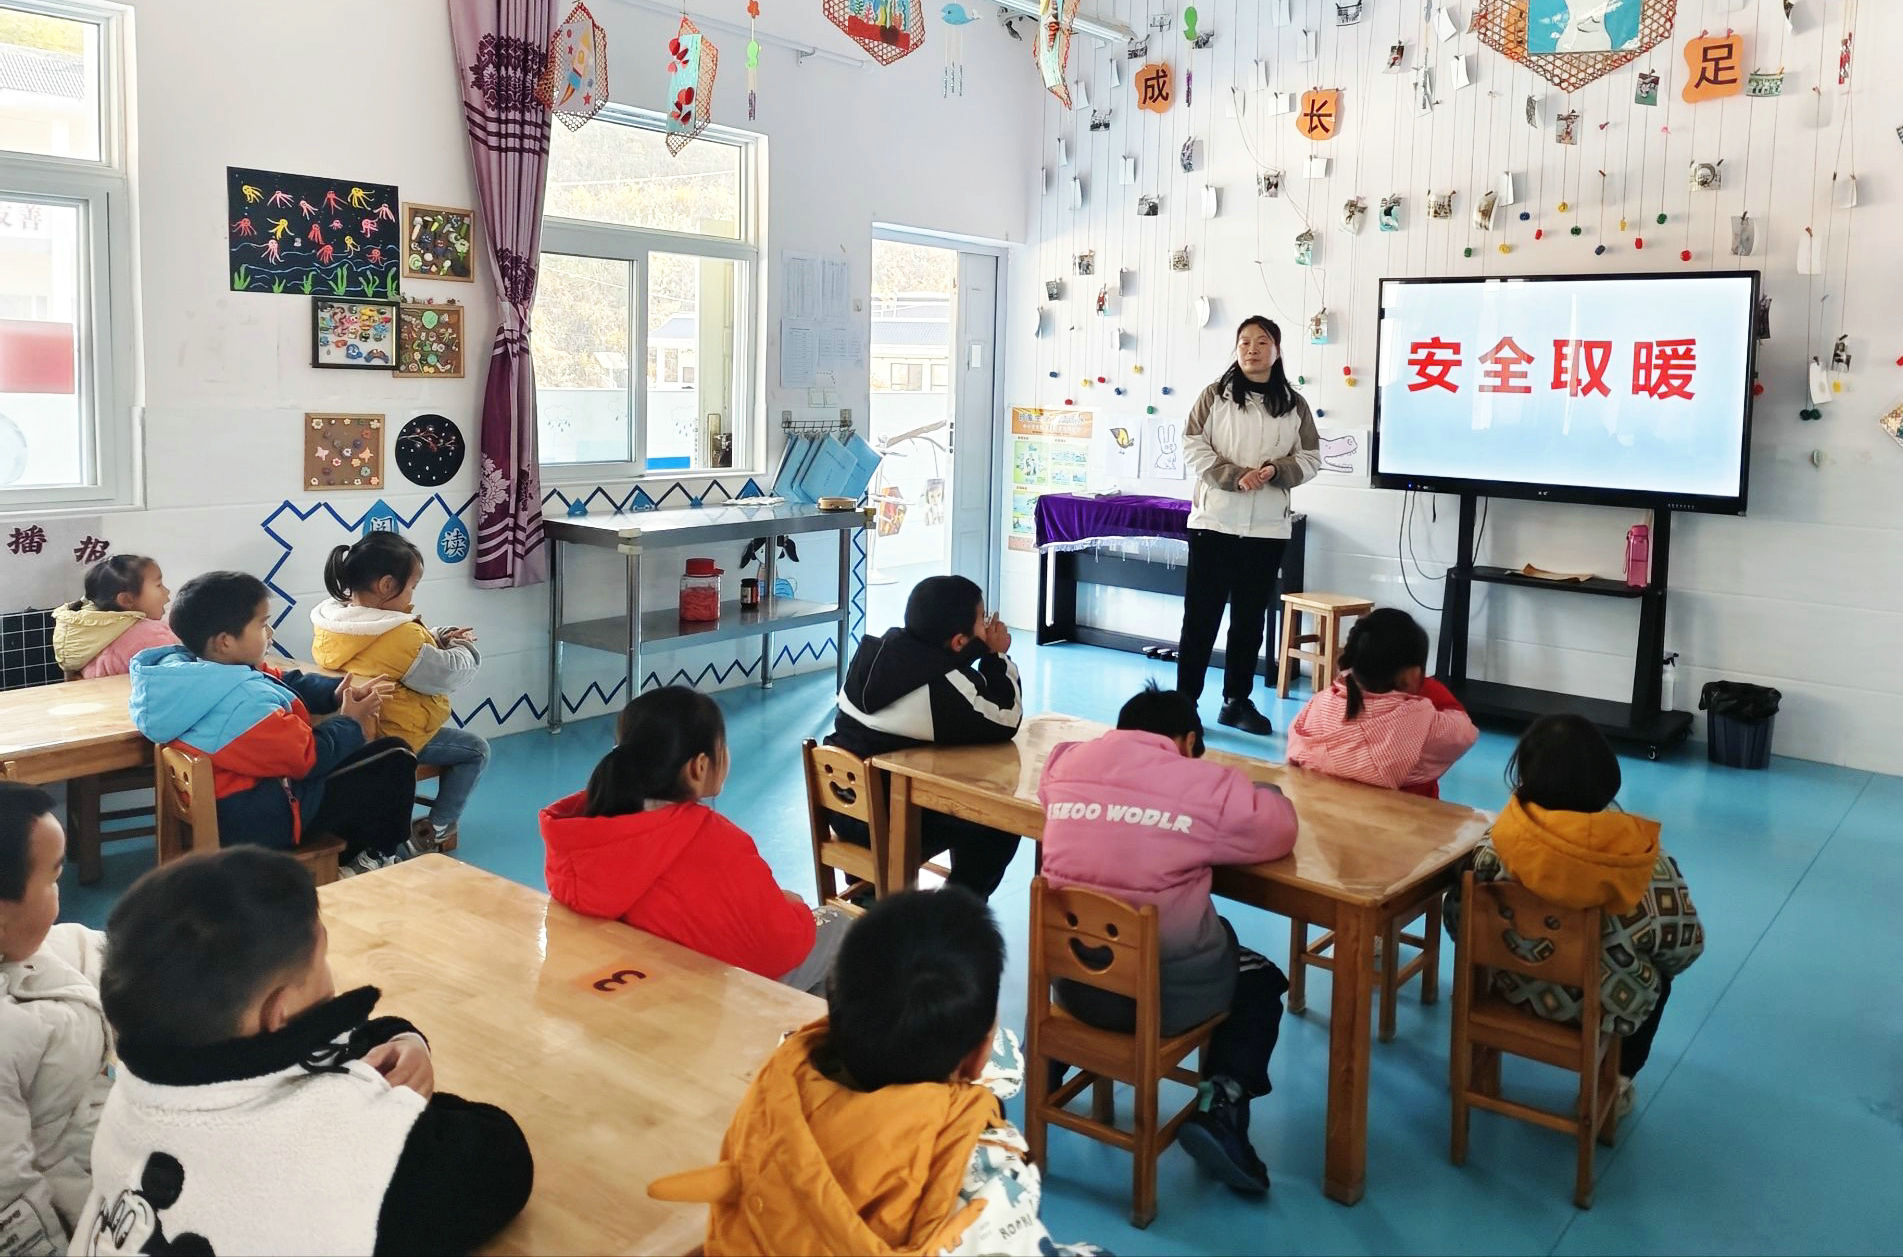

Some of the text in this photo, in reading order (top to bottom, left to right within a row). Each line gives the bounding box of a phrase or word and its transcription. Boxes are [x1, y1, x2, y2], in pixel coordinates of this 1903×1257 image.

[1694, 43, 1738, 89] 足
[1142, 69, 1170, 105] 成
[1303, 99, 1333, 135] 长
[1407, 336, 1697, 401] 安全取暖
[442, 529, 466, 557] 读
[1106, 803, 1193, 834] WODLR
[593, 970, 647, 992] 3
